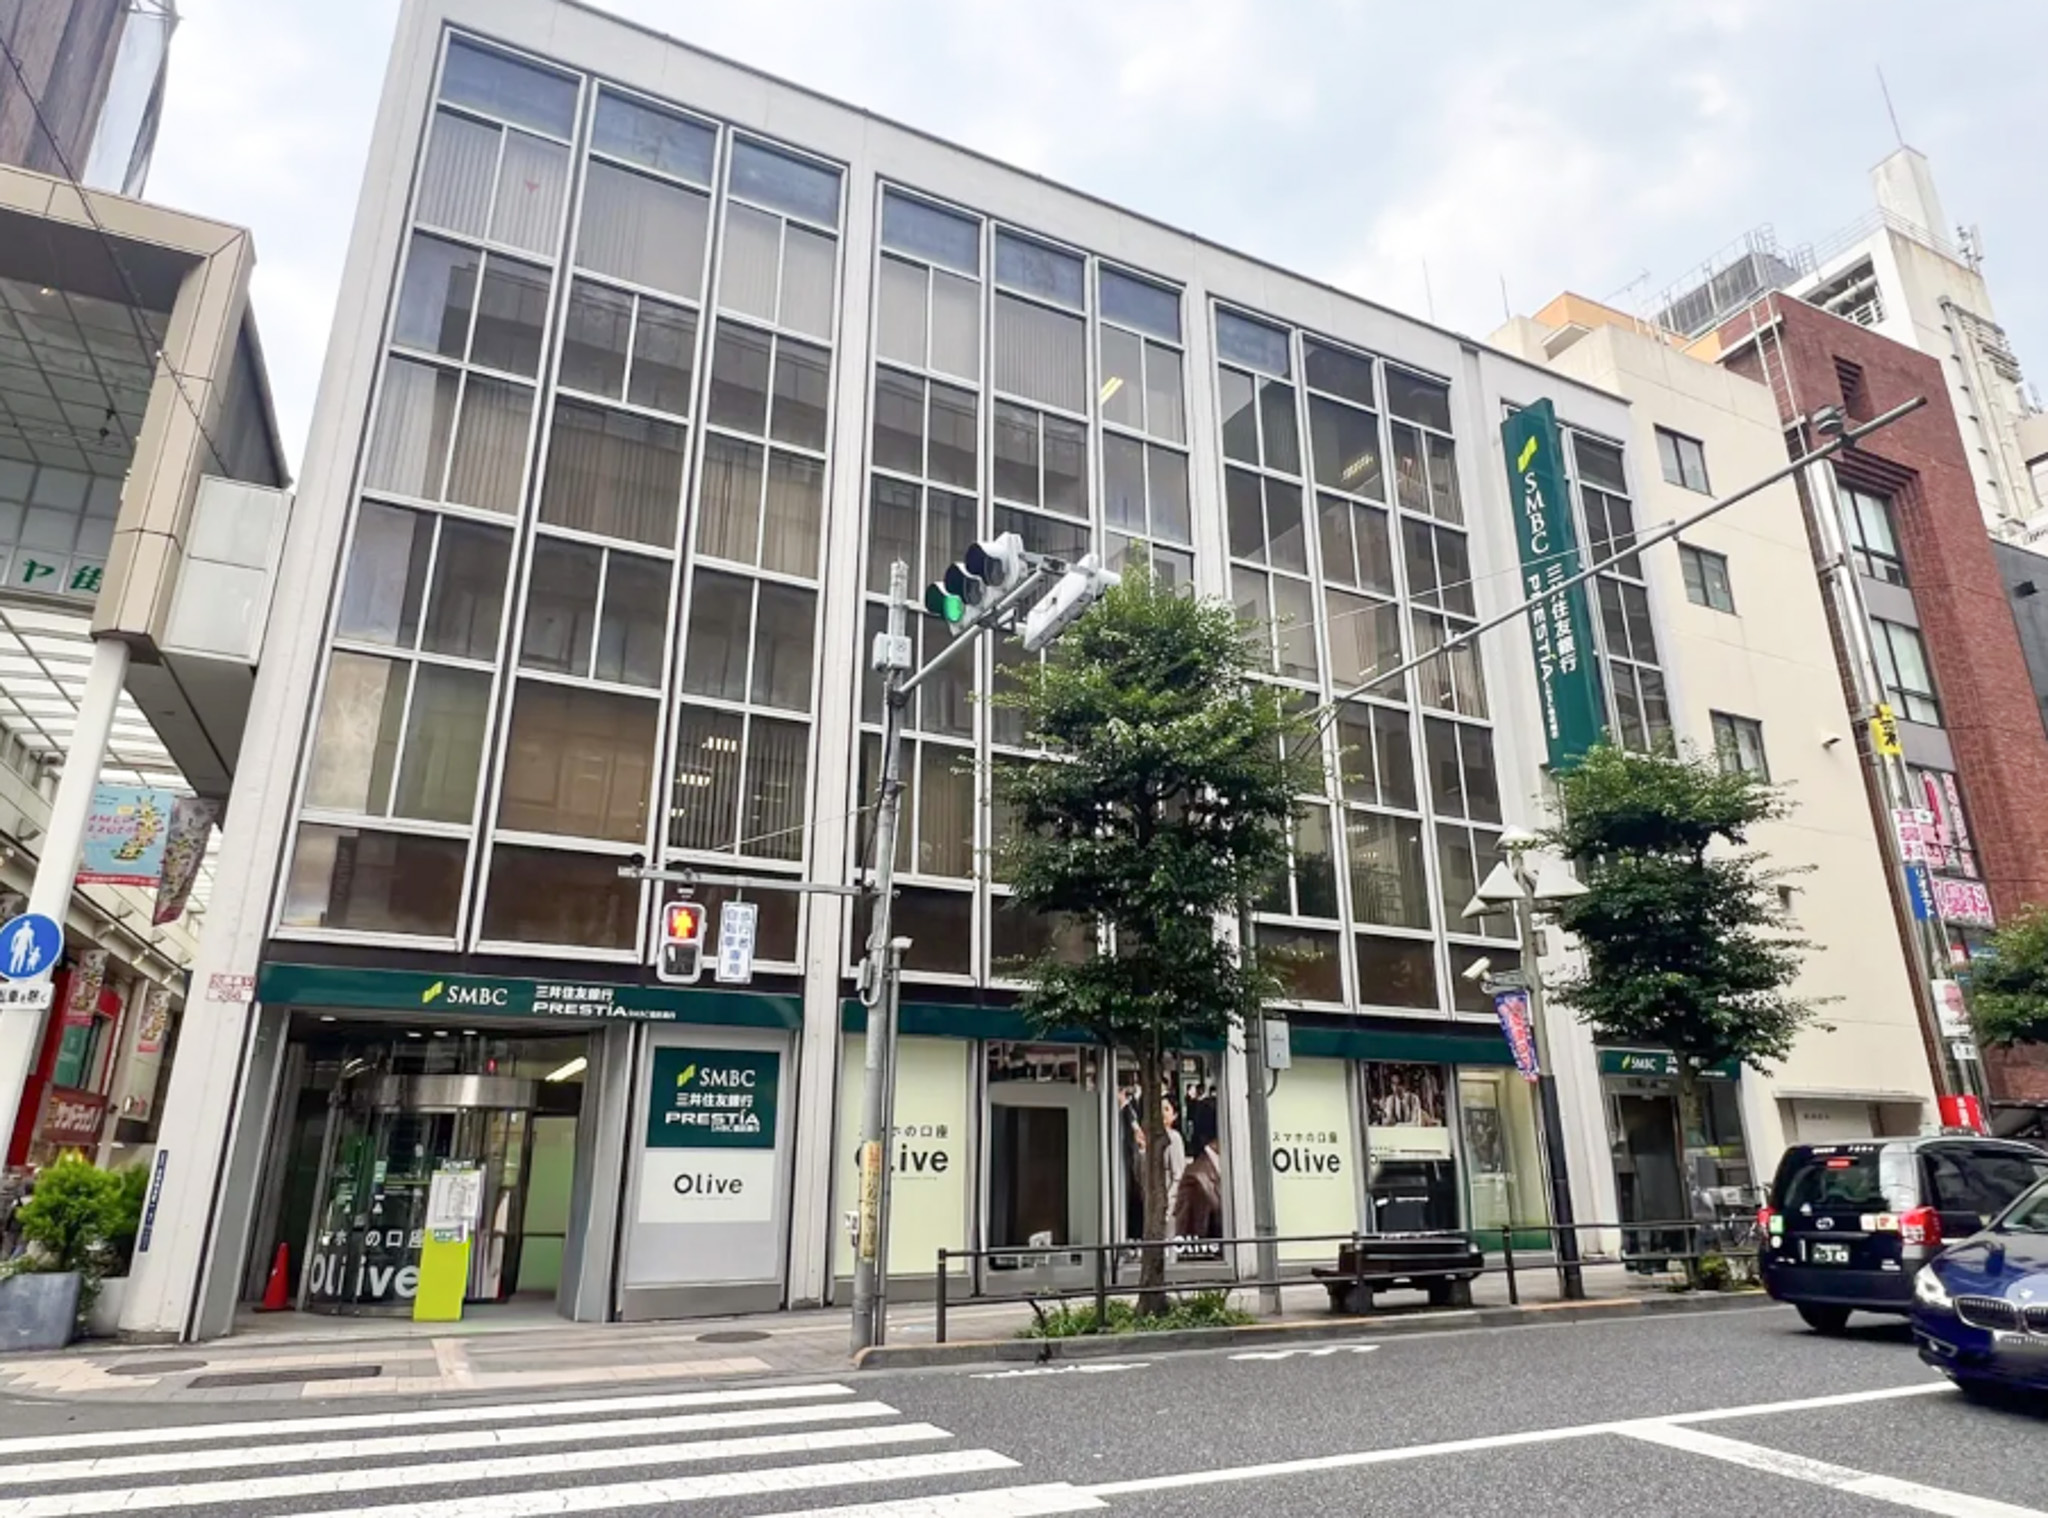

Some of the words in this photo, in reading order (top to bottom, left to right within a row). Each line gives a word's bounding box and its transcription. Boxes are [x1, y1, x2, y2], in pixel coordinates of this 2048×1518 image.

[1524, 472, 1550, 554] SMBC
[446, 985, 508, 1006] SMBC
[535, 984, 615, 1002] 三井住友銀行
[699, 1067, 756, 1088] SMBC
[675, 1092, 754, 1108] 三井住友銀行
[1272, 1147, 1342, 1173] Olive
[673, 1173, 744, 1195] Olive
